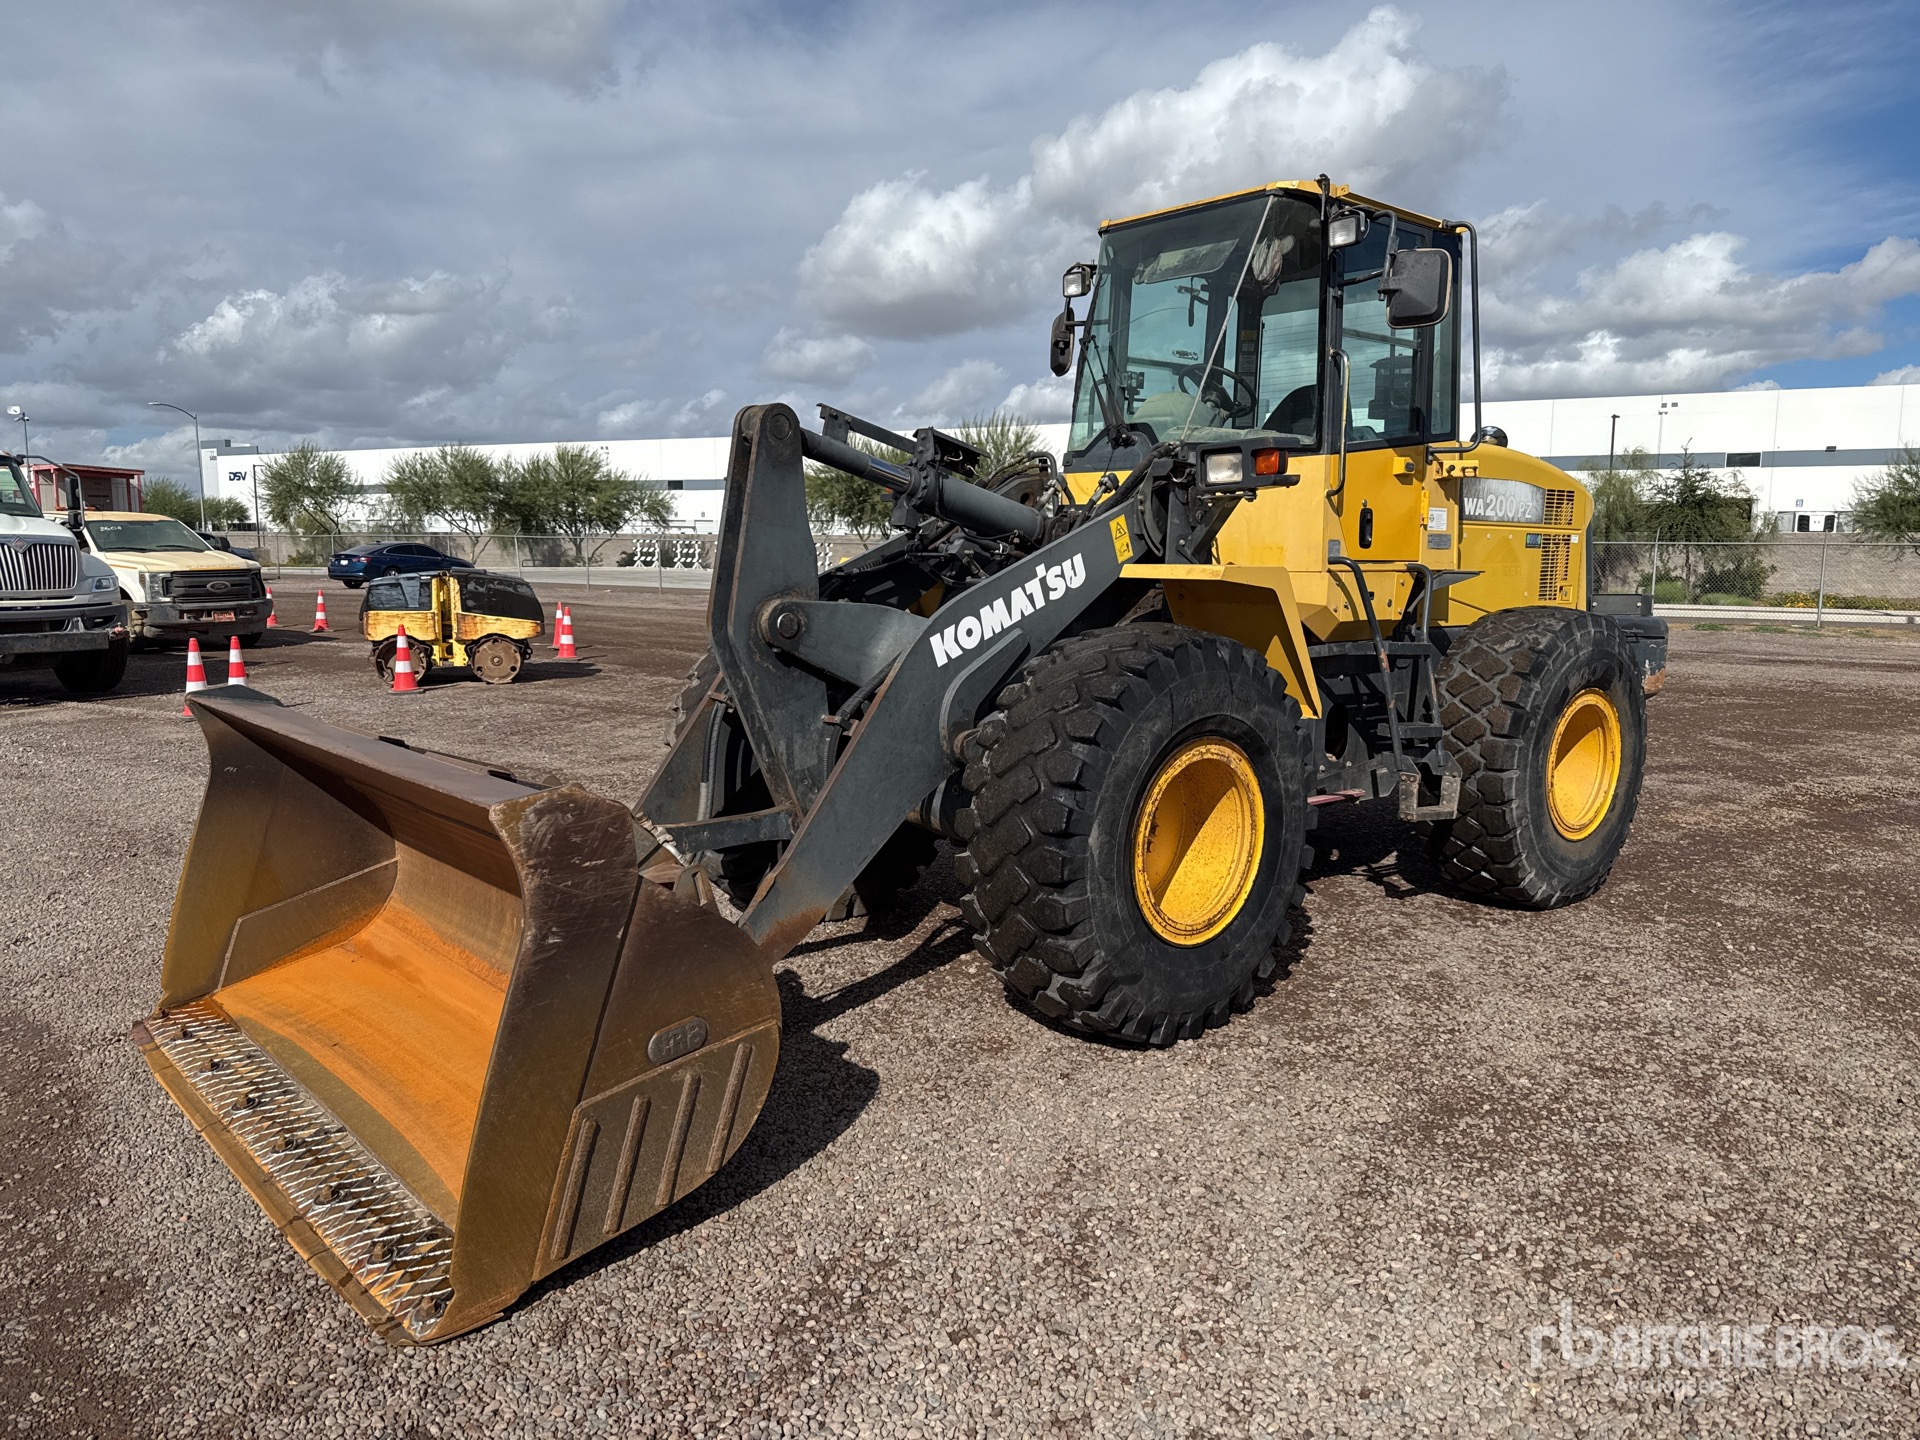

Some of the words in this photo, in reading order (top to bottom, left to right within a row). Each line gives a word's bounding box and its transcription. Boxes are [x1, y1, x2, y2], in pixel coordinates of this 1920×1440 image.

[228, 471, 247, 481] DSV
[1463, 493, 1516, 518] WA200
[1518, 501, 1533, 519] PZ
[929, 552, 1087, 668] KOMATSU
